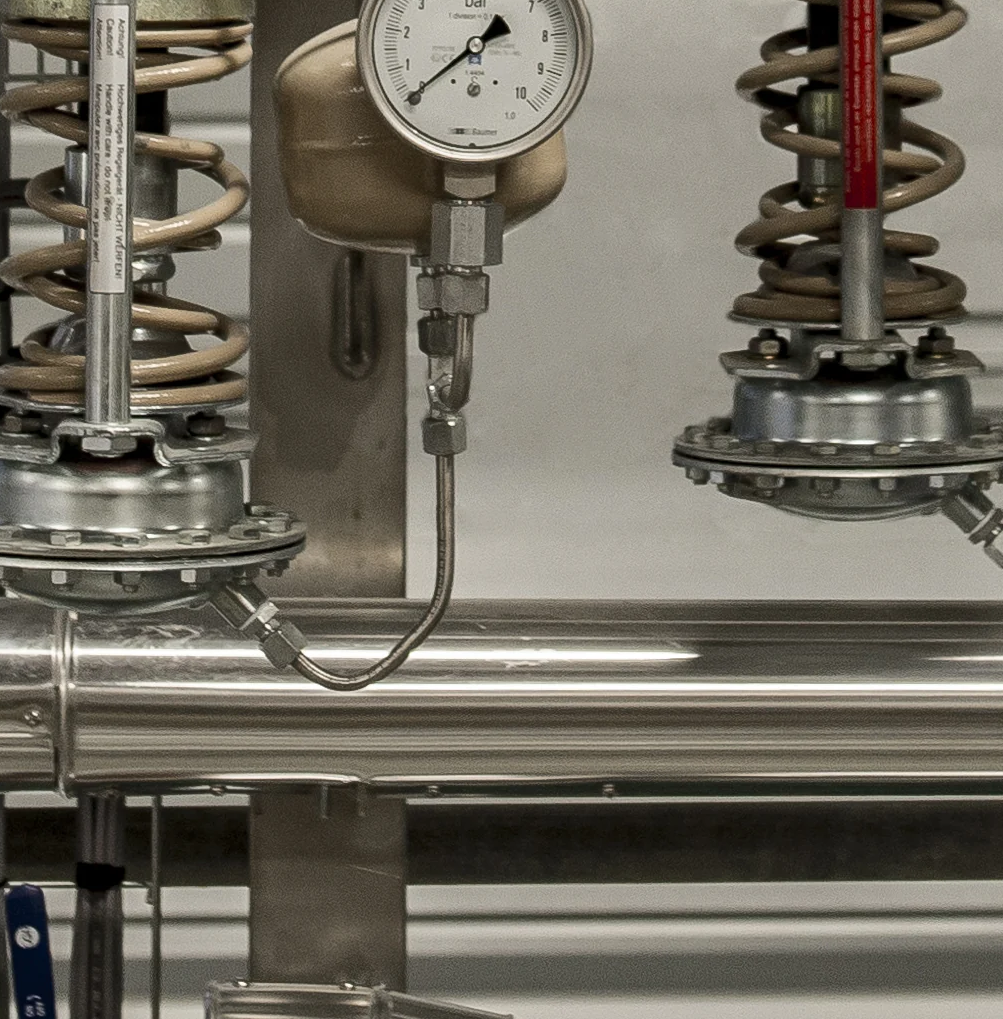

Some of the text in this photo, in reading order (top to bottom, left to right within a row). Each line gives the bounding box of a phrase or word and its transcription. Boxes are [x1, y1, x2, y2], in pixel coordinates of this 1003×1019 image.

[529, 0, 535, 13] 7
[106, 18, 115, 56] Caution!
[116, 17, 126, 59] Achtung!
[404, 26, 410, 39] 2
[542, 30, 548, 42] 8
[405, 58, 410, 71] 1
[537, 62, 544, 75] 9
[105, 84, 114, 116] Handle
[515, 87, 527, 100] 10
[115, 83, 125, 145] Hochwertiges
[105, 118, 113, 136] with
[104, 138, 112, 158] care
[104, 165, 112, 178] do
[103, 180, 112, 195] not
[115, 203, 123, 233] NICHT
